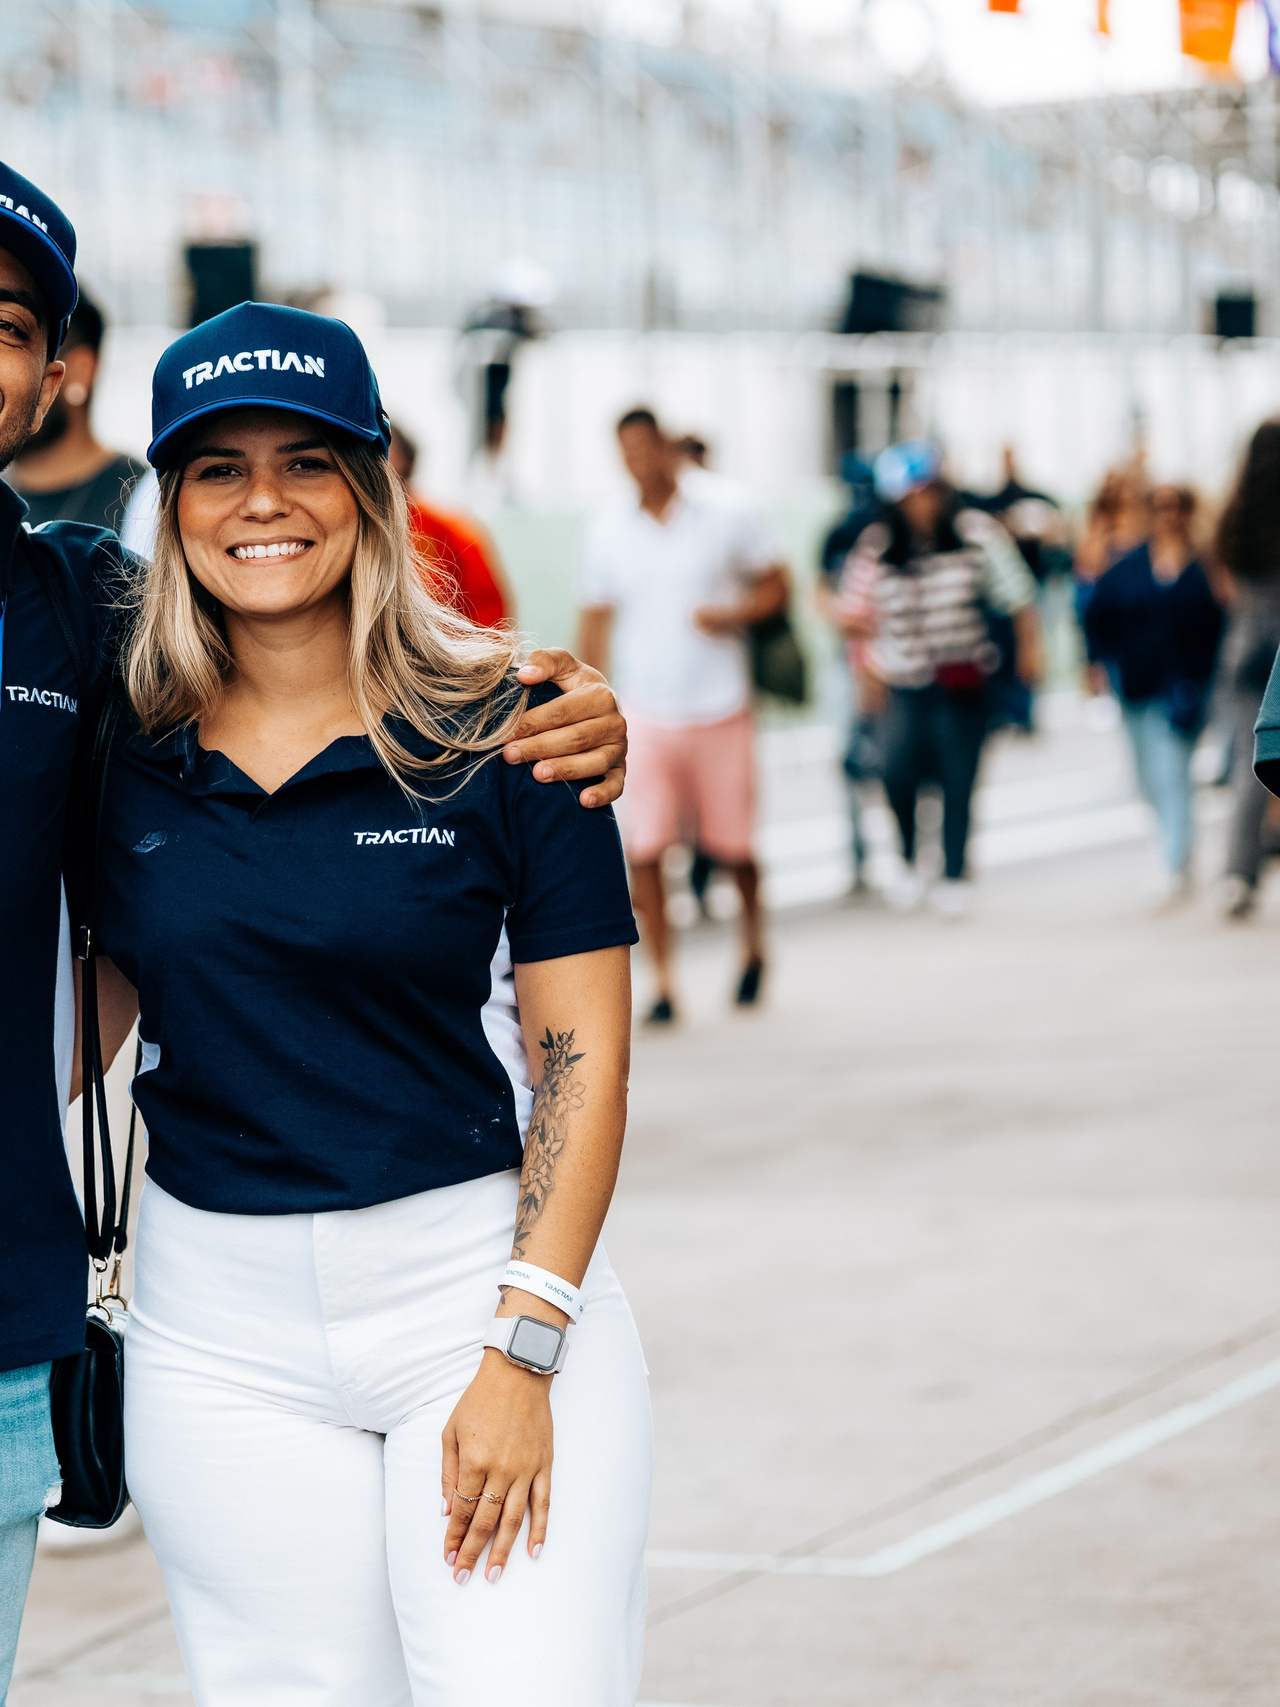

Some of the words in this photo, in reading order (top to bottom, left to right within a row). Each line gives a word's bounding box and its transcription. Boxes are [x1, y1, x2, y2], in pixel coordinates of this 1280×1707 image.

[182, 349, 325, 390] TRACTIAN
[5, 685, 78, 715] TRACTIAN
[353, 827, 456, 847] TRACTIAN
[544, 1281, 574, 1303] TRACTIAN
